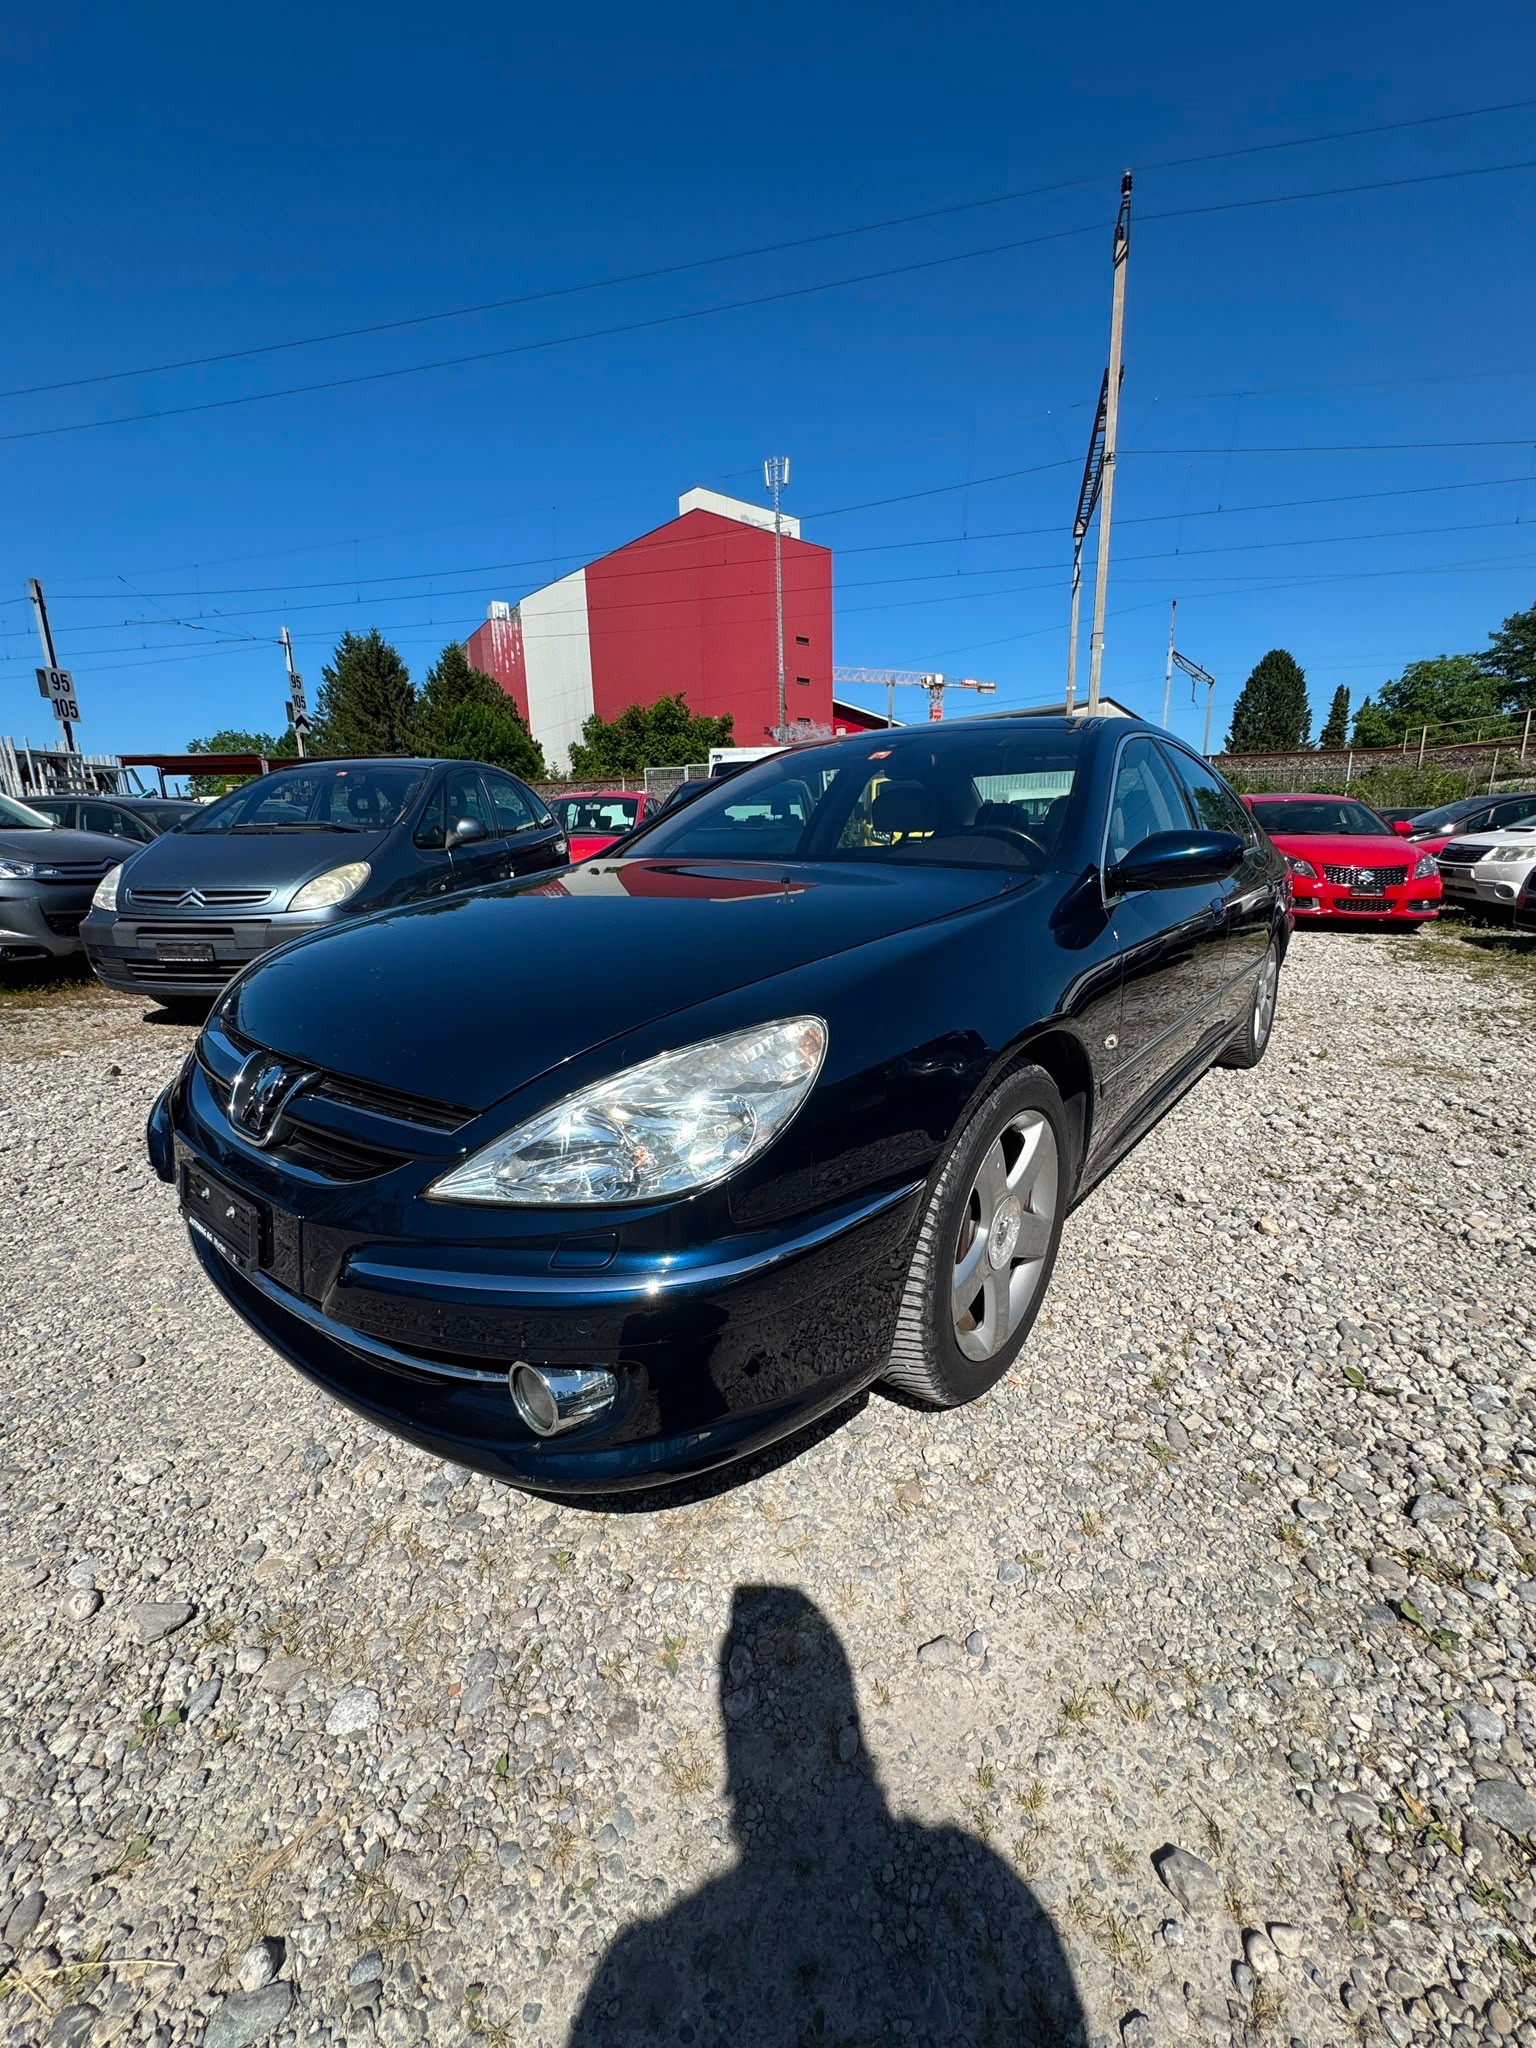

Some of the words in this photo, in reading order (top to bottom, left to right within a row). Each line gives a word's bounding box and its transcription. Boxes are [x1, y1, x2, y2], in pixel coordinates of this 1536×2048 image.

[50, 671, 70, 692] 95
[290, 674, 302, 690] 95
[52, 697, 79, 719] 105
[292, 694, 307, 710] 105
